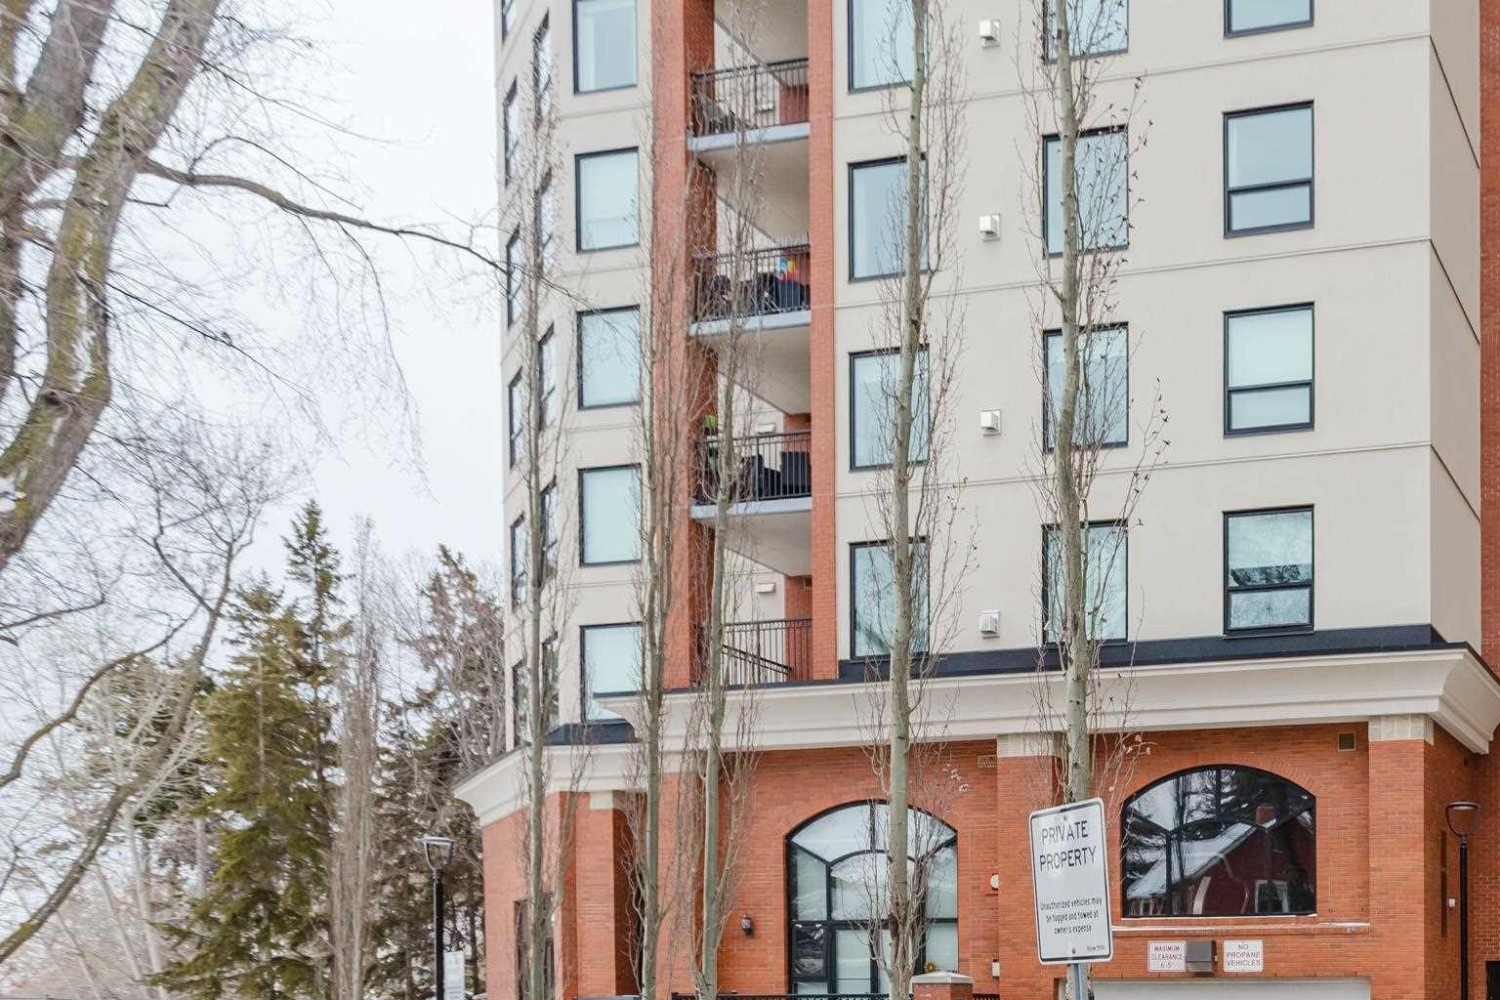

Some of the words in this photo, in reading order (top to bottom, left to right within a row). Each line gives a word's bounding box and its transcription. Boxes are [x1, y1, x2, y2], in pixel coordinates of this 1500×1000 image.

[1042, 820, 1089, 845] PRIVATE
[1039, 846, 1097, 872] PROPERTY
[1041, 900, 1070, 910] Unauthorized
[1071, 898, 1090, 908] vehicles
[1091, 897, 1102, 906] may
[1068, 912, 1077, 920] and
[1078, 911, 1092, 920] towed
[1151, 953, 1182, 961] CLEARANCE
